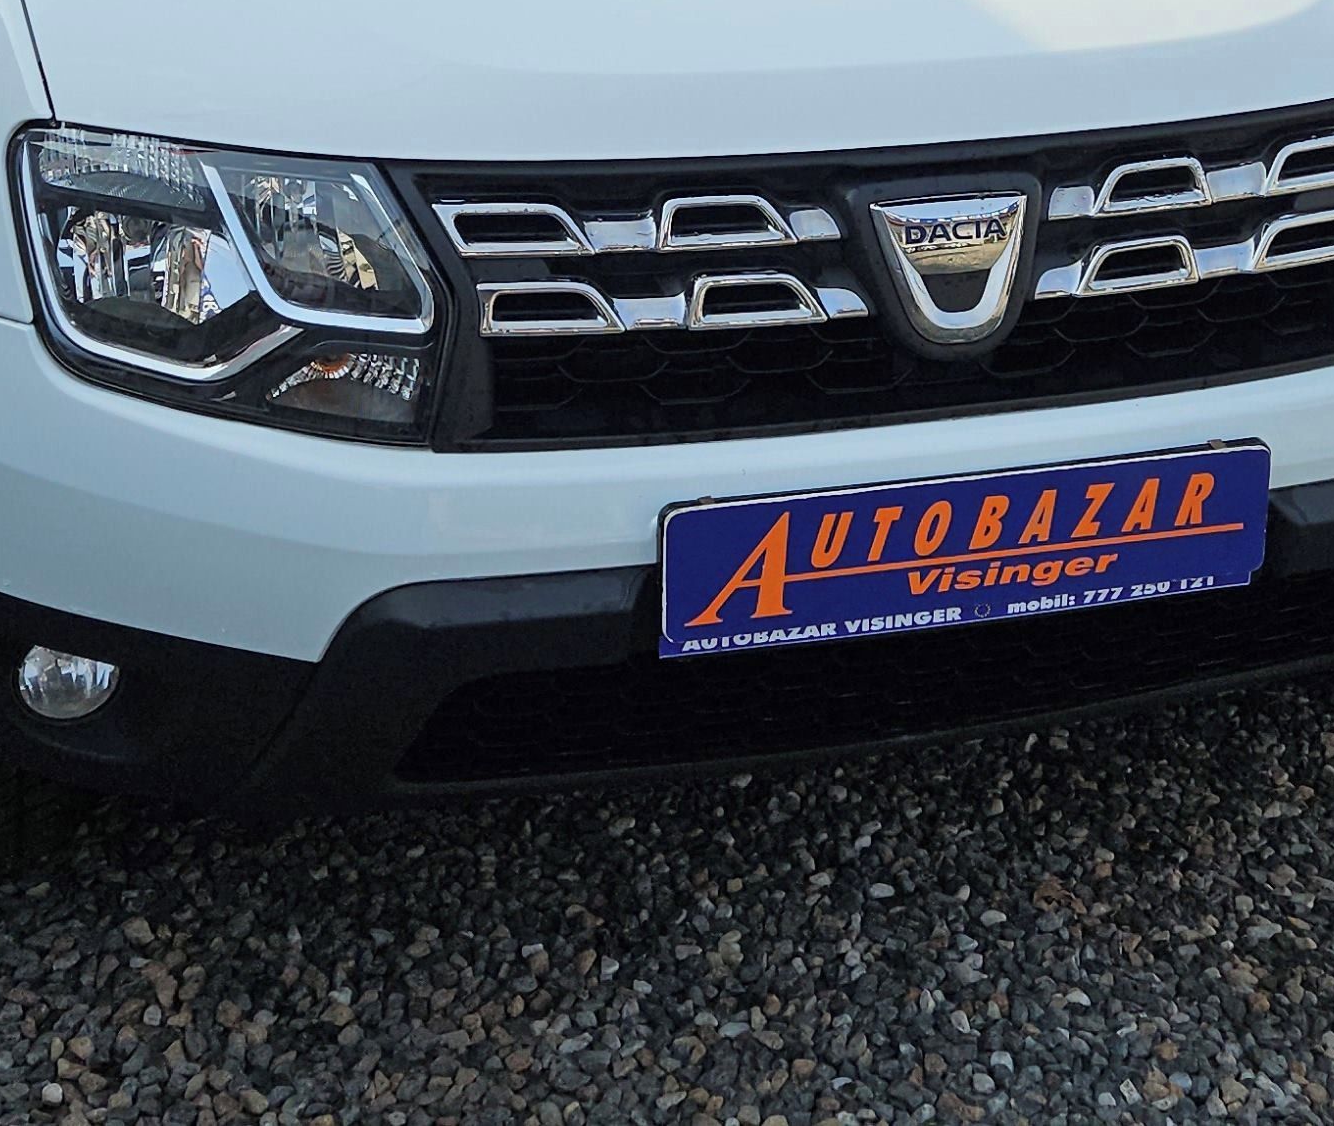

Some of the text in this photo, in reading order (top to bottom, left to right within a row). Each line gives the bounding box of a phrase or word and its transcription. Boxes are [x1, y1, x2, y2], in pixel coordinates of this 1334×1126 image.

[905, 218, 1008, 245] DACIA
[684, 472, 1217, 628] AUTOBAZAR
[907, 552, 1119, 596] Visinger
[682, 574, 1216, 652] AUTOBAZAR VISINGER mobil: 777 250 121
